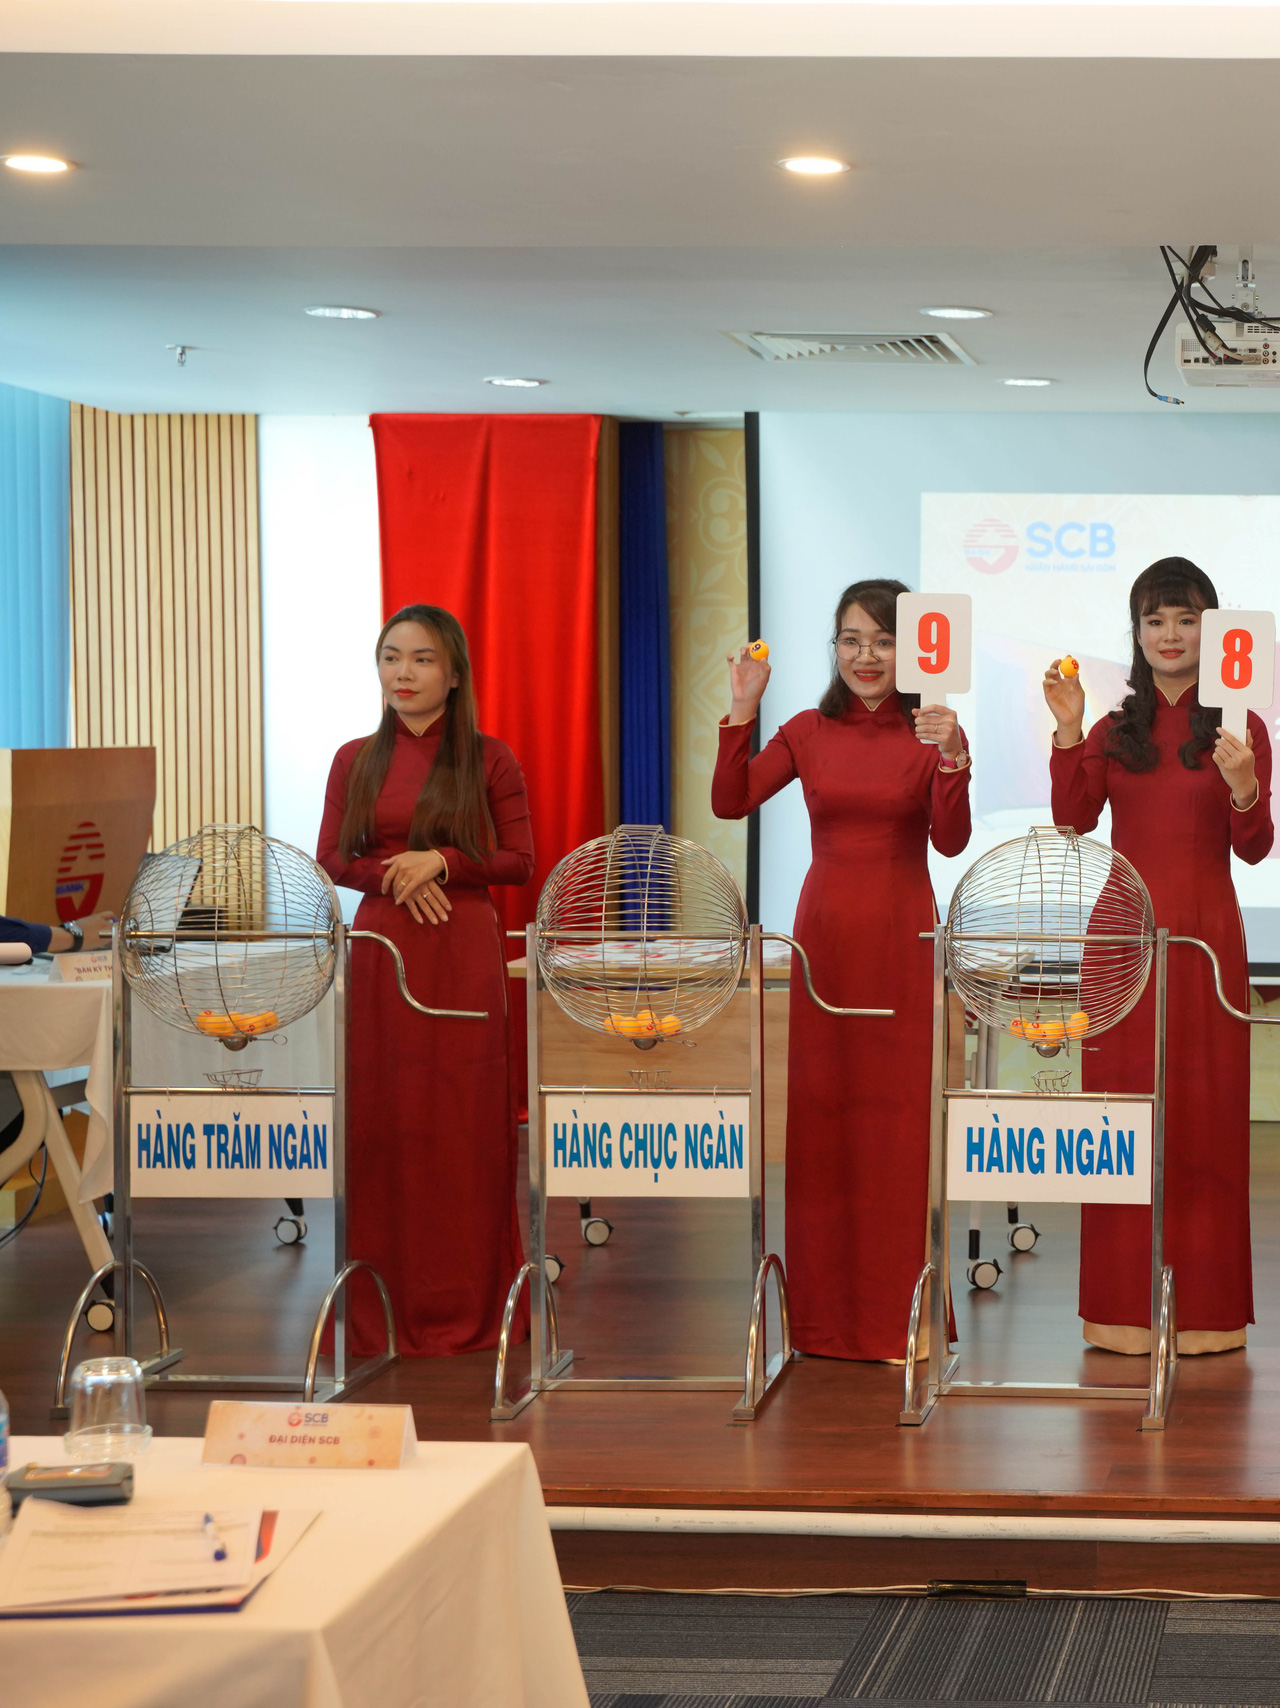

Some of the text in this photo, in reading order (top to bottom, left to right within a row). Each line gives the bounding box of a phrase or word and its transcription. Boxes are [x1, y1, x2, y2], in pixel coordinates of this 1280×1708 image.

[1026, 521, 1117, 558] SCB
[918, 612, 950, 674] 9
[1221, 628, 1253, 690] 8
[138, 1110, 327, 1170] HÀNG TRĂM NGÀN
[553, 1110, 744, 1183] HÀNG CHỤC NGÀN
[966, 1113, 1135, 1176] HÀNG NGÀN
[304, 1412, 328, 1423] SCB
[318, 1435, 341, 1445] SCB
